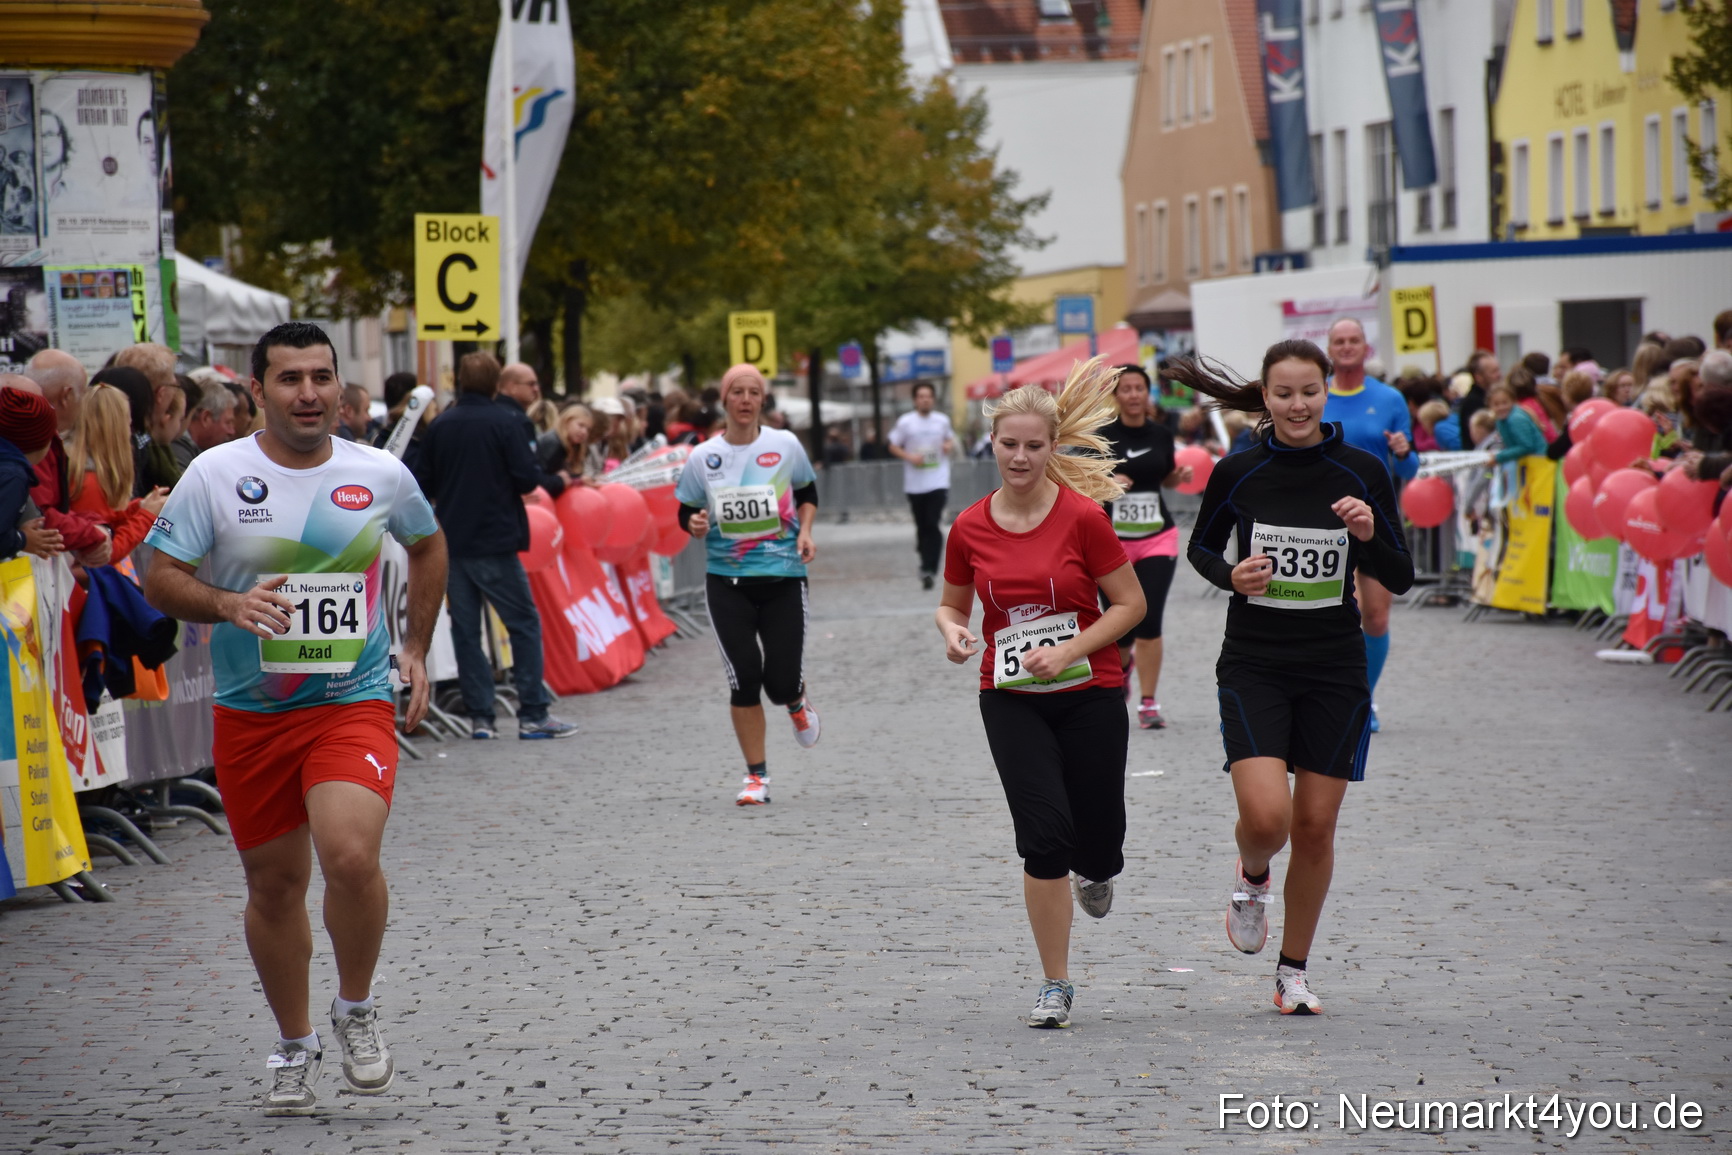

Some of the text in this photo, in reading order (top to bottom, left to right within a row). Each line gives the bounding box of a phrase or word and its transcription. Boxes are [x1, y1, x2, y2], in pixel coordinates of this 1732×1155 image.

[1554, 82, 1587, 118] HOTEL
[426, 221, 489, 243] Block
[437, 253, 478, 312] C
[1395, 289, 1432, 304] Block
[735, 316, 768, 328] Block
[1405, 308, 1428, 339] D
[743, 333, 764, 363] D
[337, 491, 369, 505] Hervis
[238, 508, 272, 517] PARTL
[722, 498, 771, 520] 5301
[1119, 504, 1155, 521] 5317
[239, 516, 273, 525] Neumarkt
[1254, 532, 1333, 546] PARTL Neumarkt
[300, 583, 350, 593] Neumarkt
[997, 623, 1066, 648] PARTL Neumarkt
[298, 644, 332, 659] Azad
